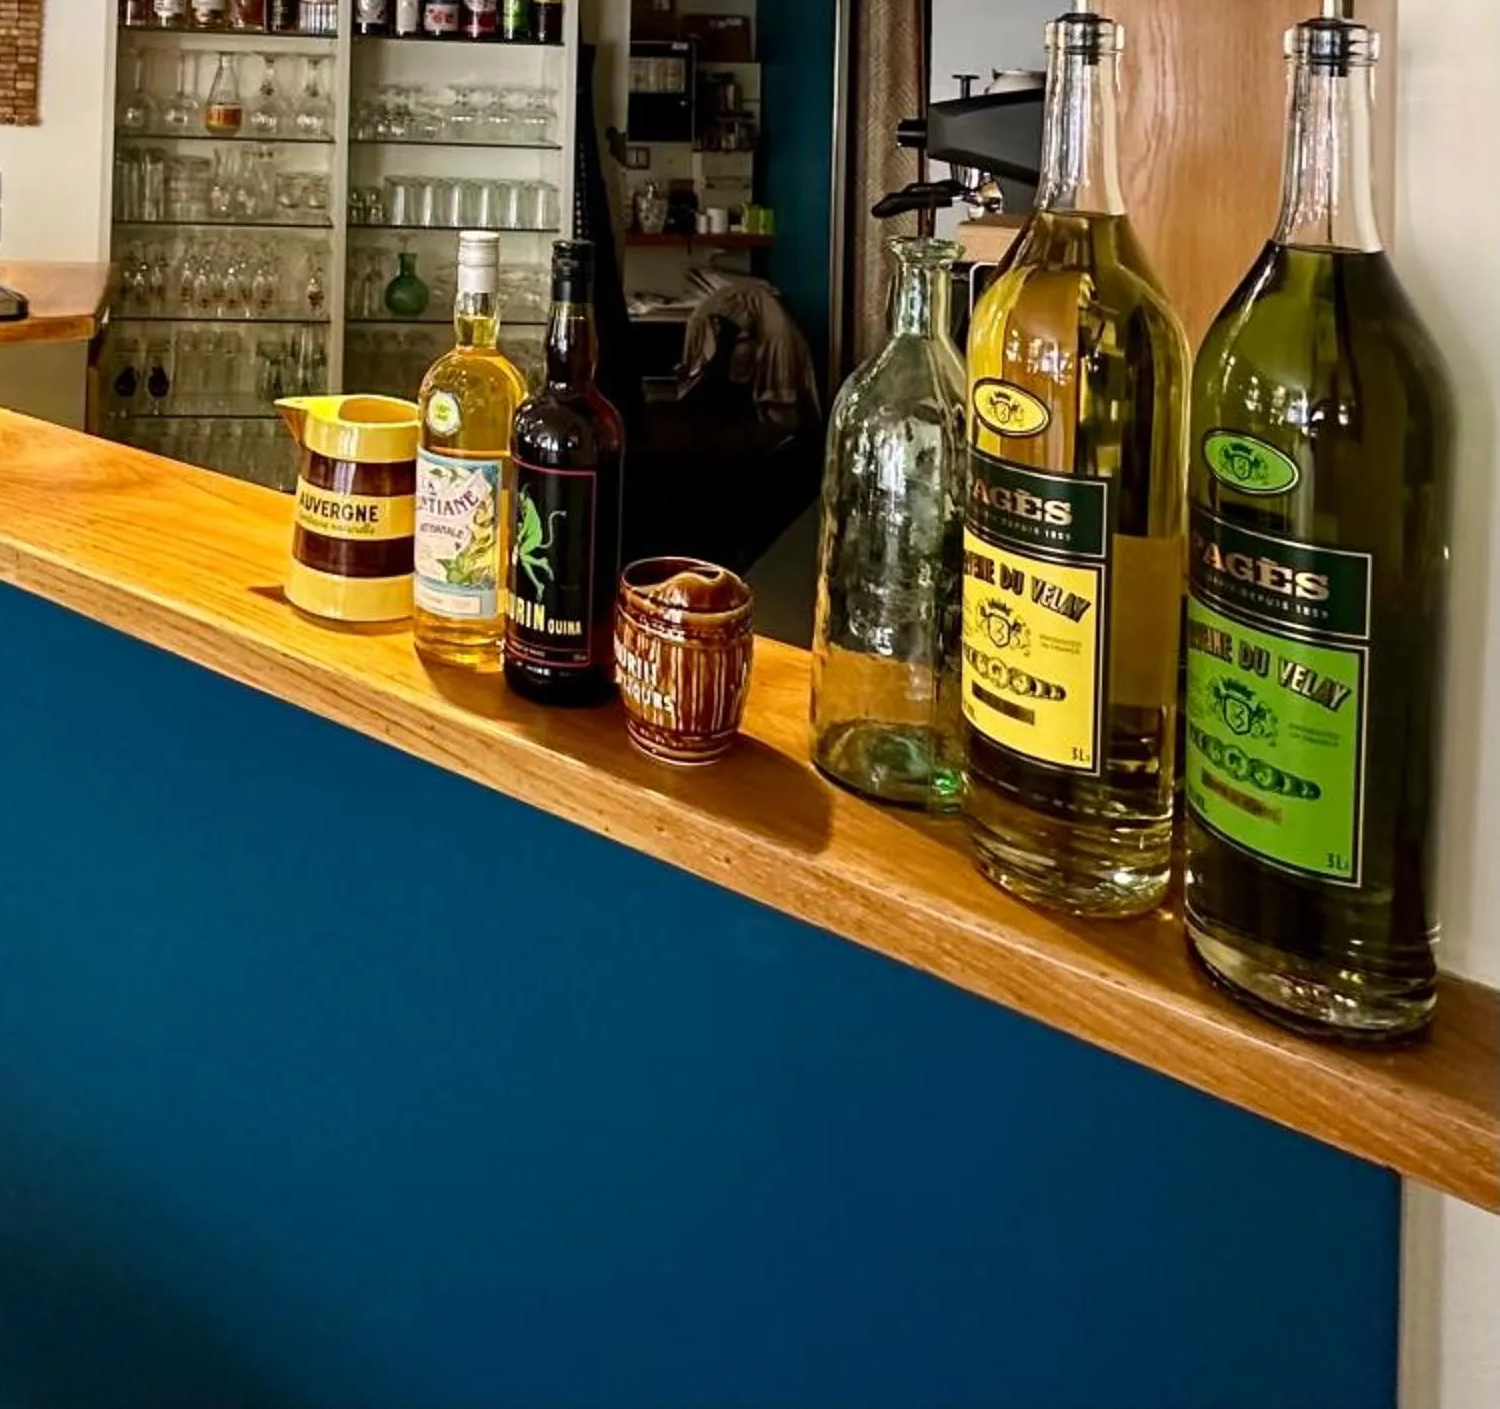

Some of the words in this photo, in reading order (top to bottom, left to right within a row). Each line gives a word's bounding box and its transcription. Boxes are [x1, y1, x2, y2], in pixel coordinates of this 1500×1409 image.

[972, 478, 1073, 526] AGÈS
[1000, 562, 1025, 596] DU
[1030, 575, 1092, 624] VELAY
[1202, 542, 1330, 602] AGÈS
[1238, 638, 1271, 678] DU
[1278, 655, 1352, 712] VELAY
